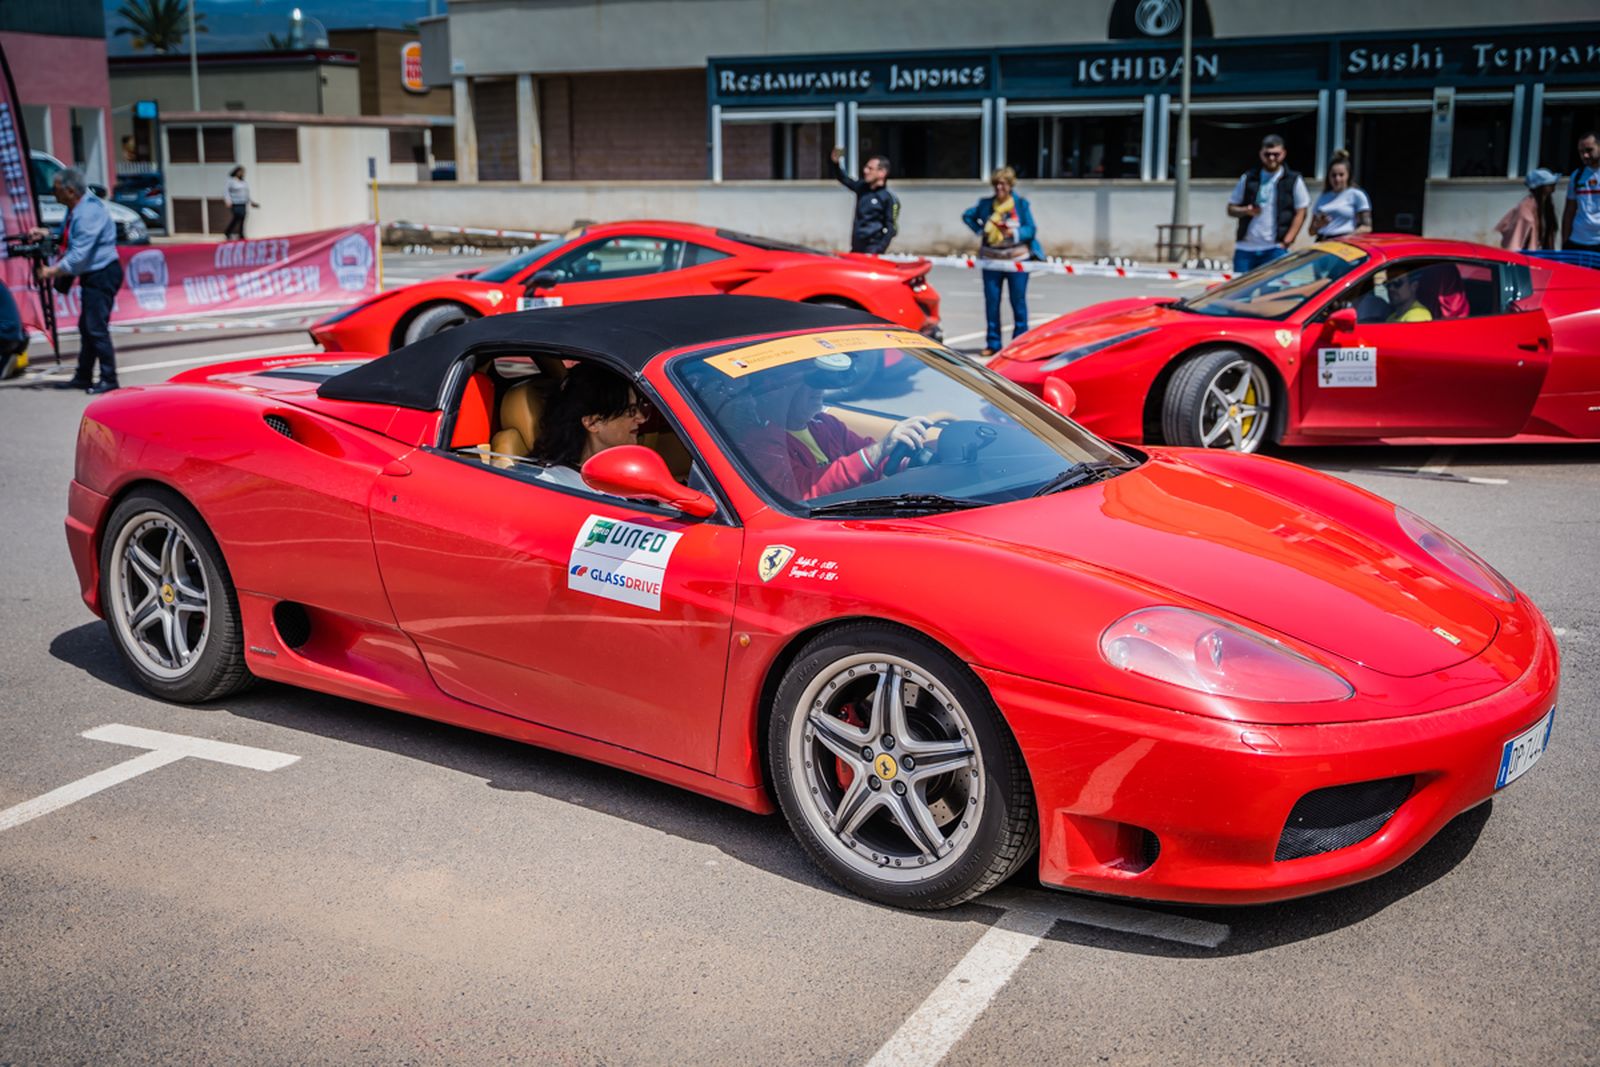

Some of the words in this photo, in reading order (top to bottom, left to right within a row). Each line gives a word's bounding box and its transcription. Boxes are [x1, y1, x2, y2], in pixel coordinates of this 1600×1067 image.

[1078, 54, 1219, 82] ICHIBAN
[1347, 42, 1445, 73] Sushi
[719, 69, 871, 91] Restaurante
[889, 64, 986, 91] Japones
[610, 524, 668, 553] UNED
[590, 568, 660, 595] GLASSDRIVE
